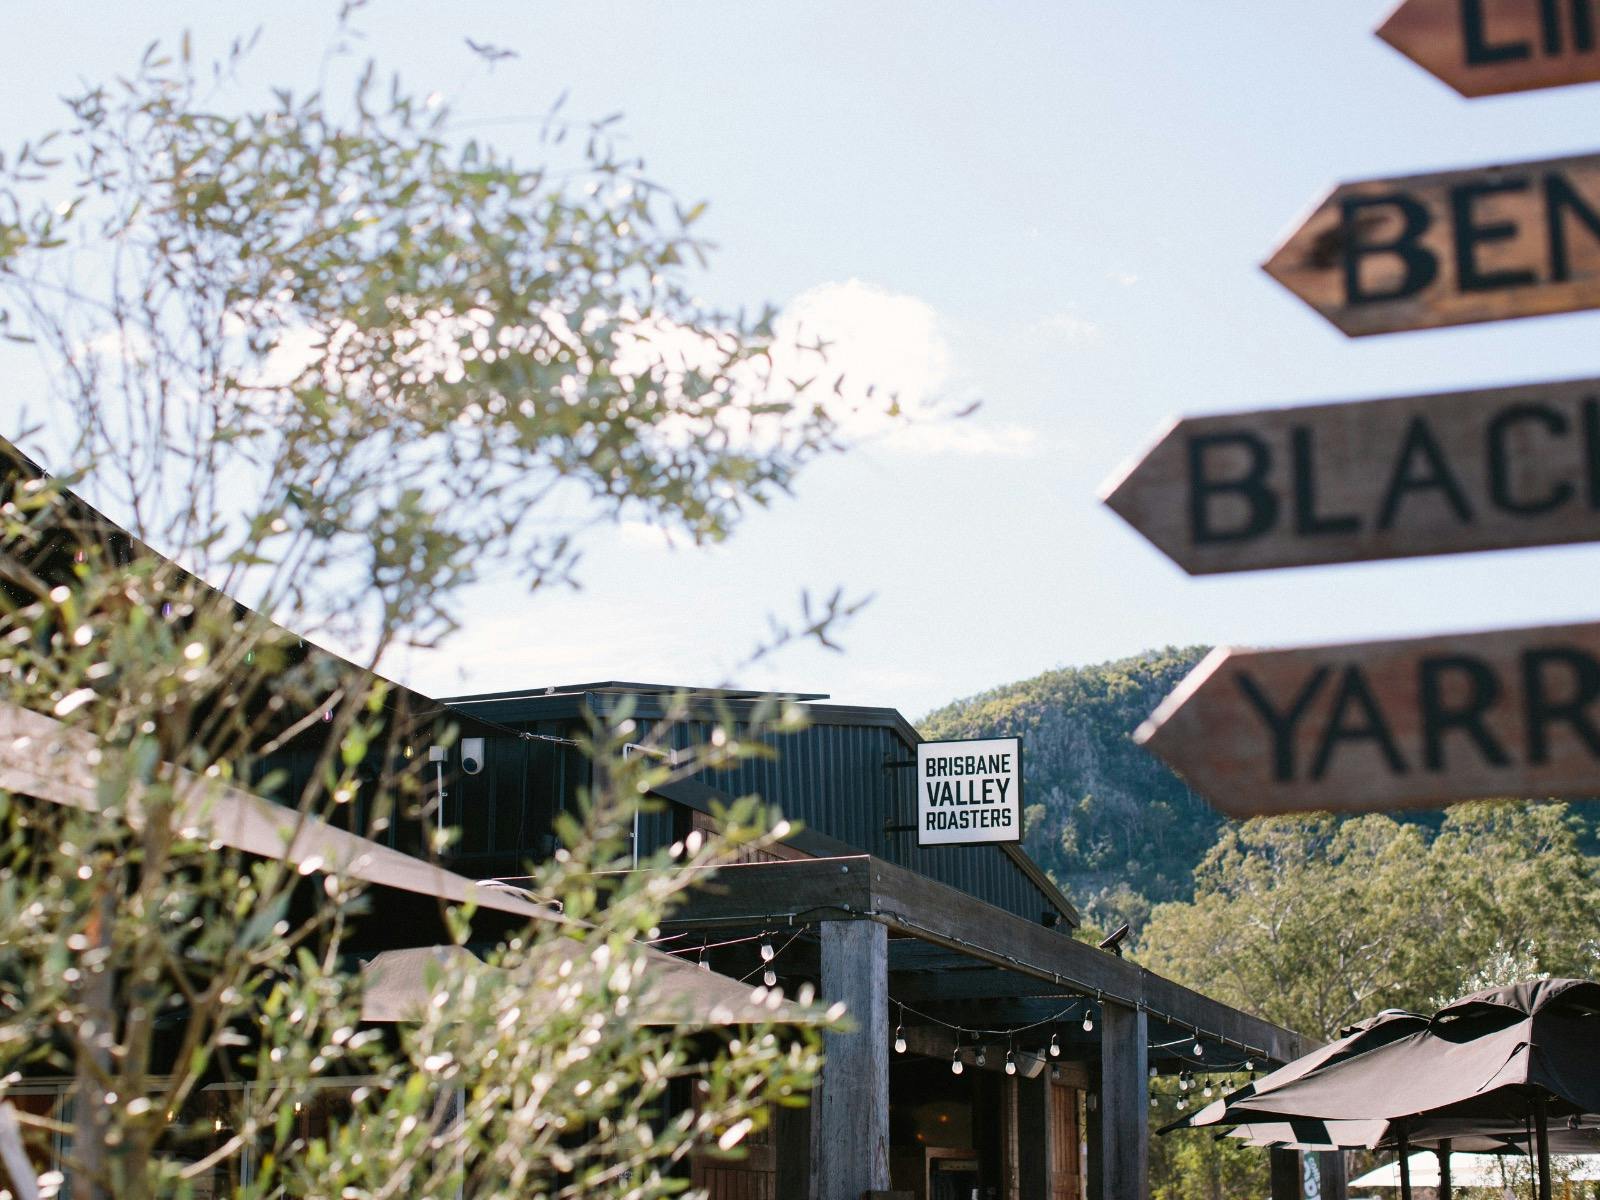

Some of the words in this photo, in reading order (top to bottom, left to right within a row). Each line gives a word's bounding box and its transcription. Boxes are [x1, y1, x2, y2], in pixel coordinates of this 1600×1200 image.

[1234, 646, 1600, 783] YARR
[926, 754, 1011, 777] BRISBANE
[926, 778, 1010, 807] VALLEY
[926, 808, 1011, 831] ROASTERS
